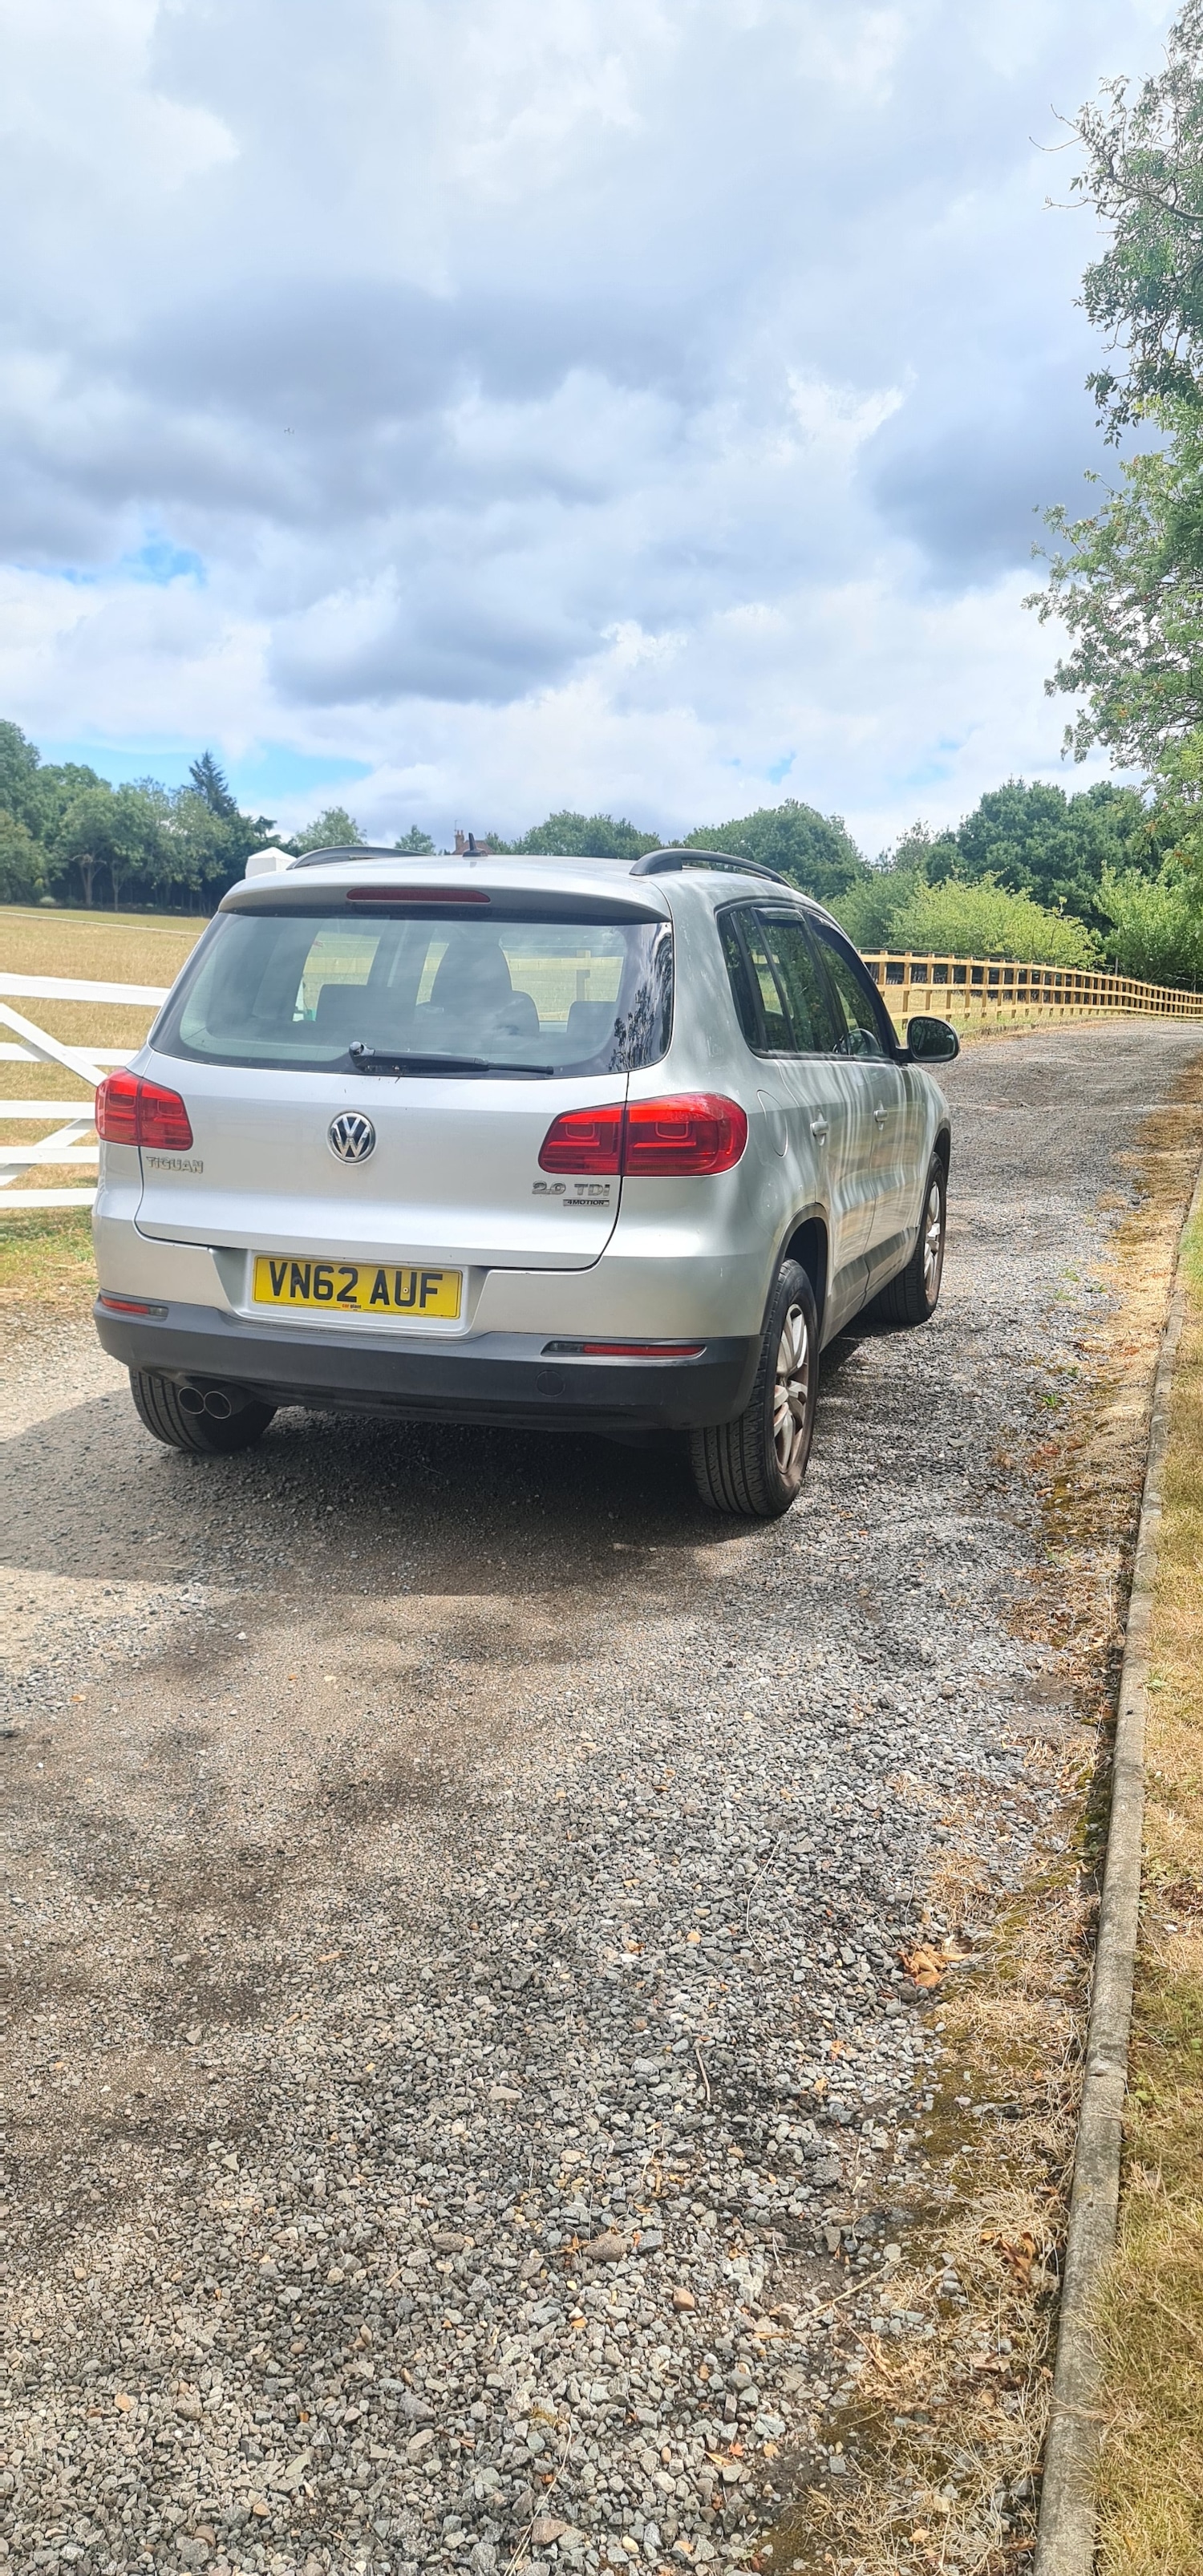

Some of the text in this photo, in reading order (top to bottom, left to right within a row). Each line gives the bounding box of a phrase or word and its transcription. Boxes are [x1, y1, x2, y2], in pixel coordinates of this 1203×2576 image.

[146, 1156, 204, 1174] TIGUAN
[532, 1181, 610, 1197] 2.0 TDI
[269, 1261, 444, 1308] VN62 AUF
